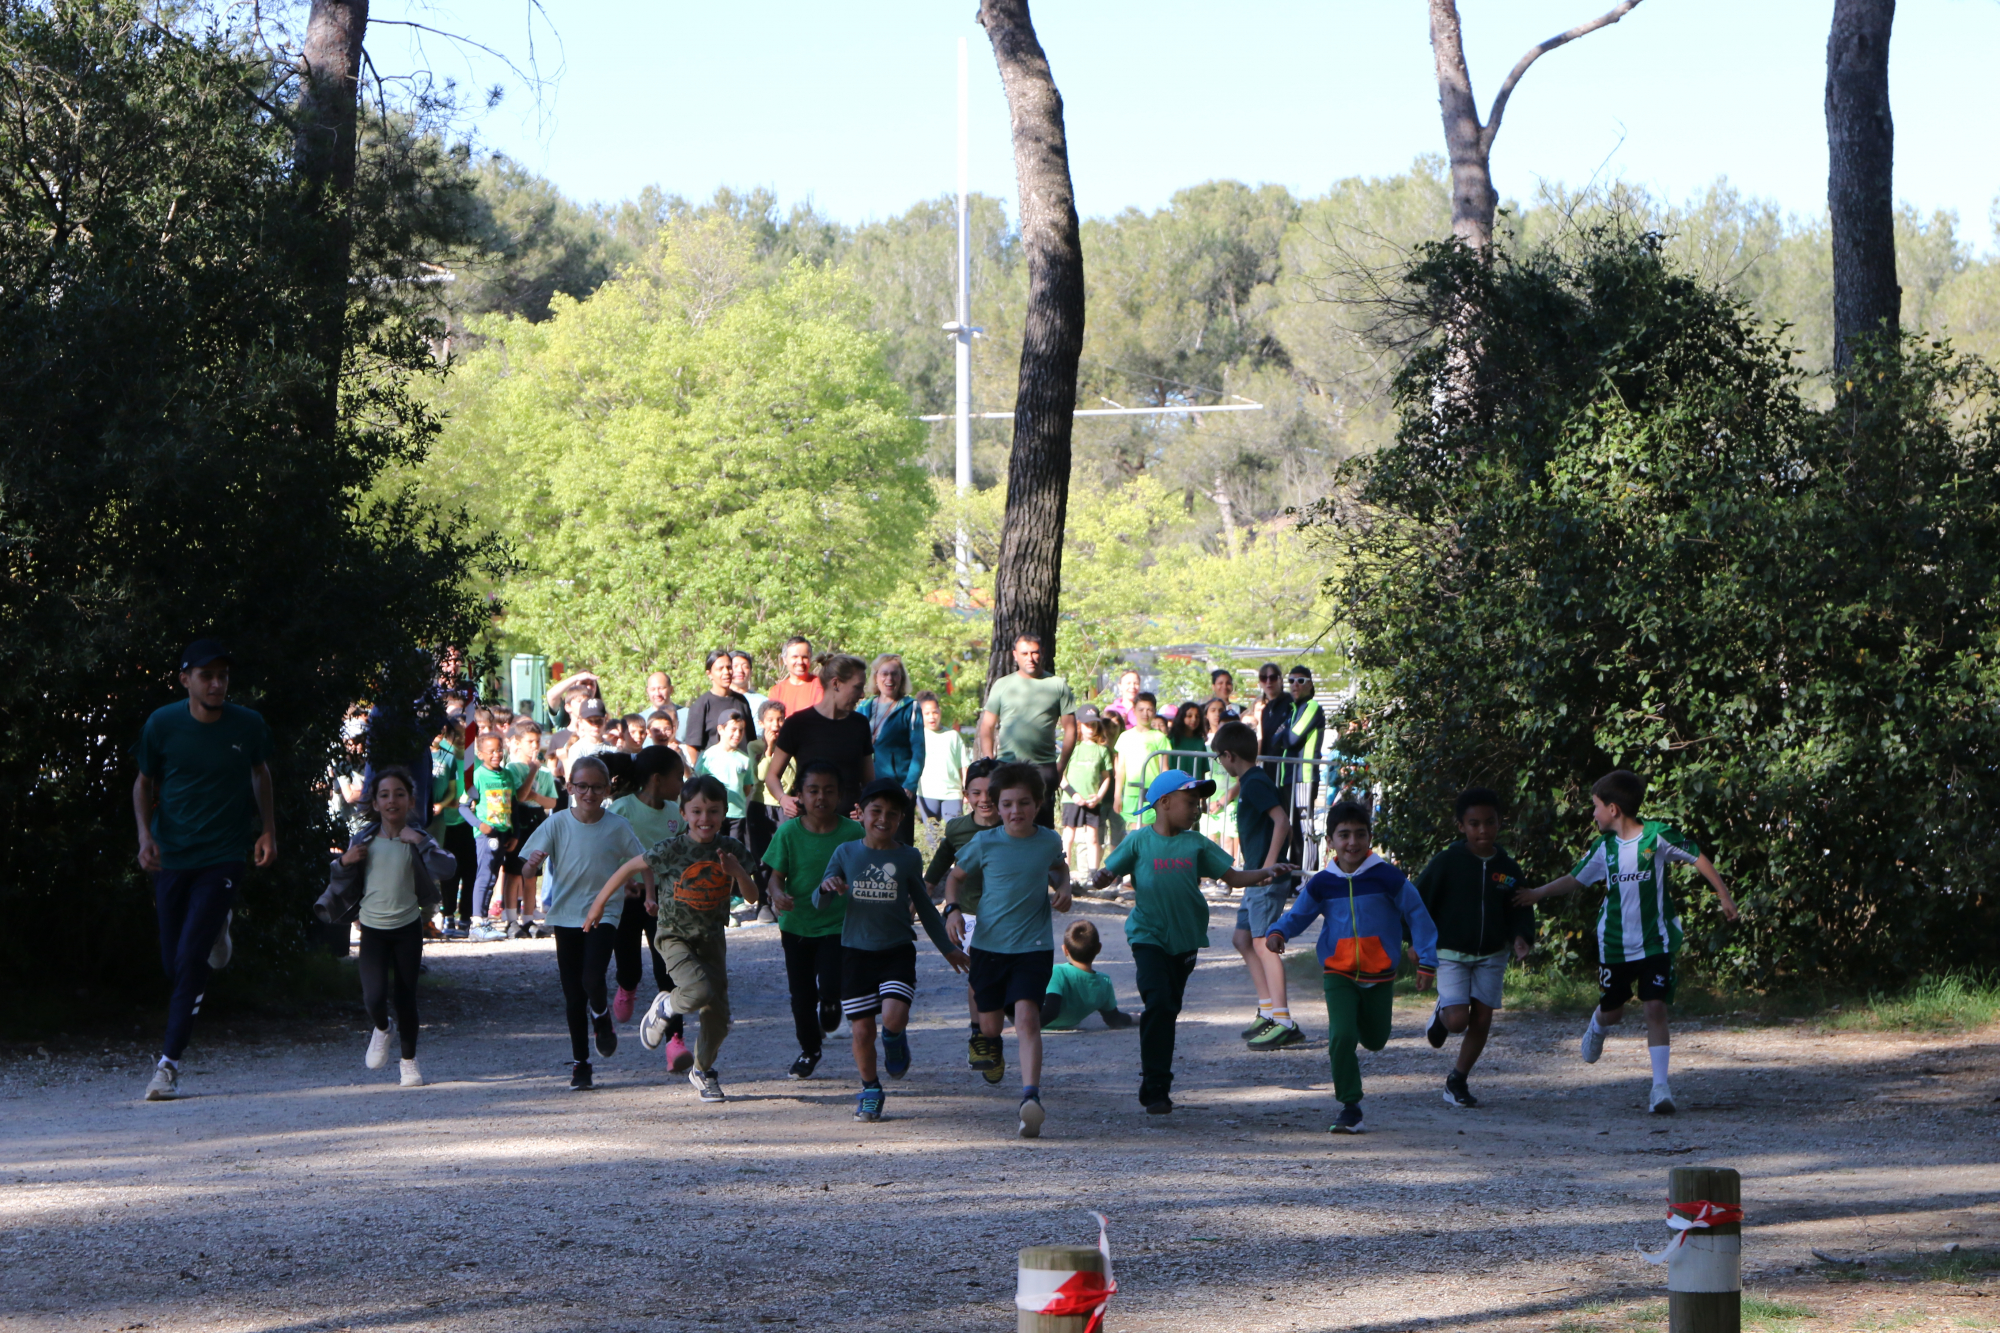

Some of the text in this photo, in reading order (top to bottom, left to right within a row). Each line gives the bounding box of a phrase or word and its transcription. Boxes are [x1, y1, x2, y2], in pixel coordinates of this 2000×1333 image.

[1153, 857, 1193, 870] BOSS
[1619, 870, 1651, 882] GREE
[853, 880, 898, 890] OUTDOOR
[855, 890, 895, 899] CALLING
